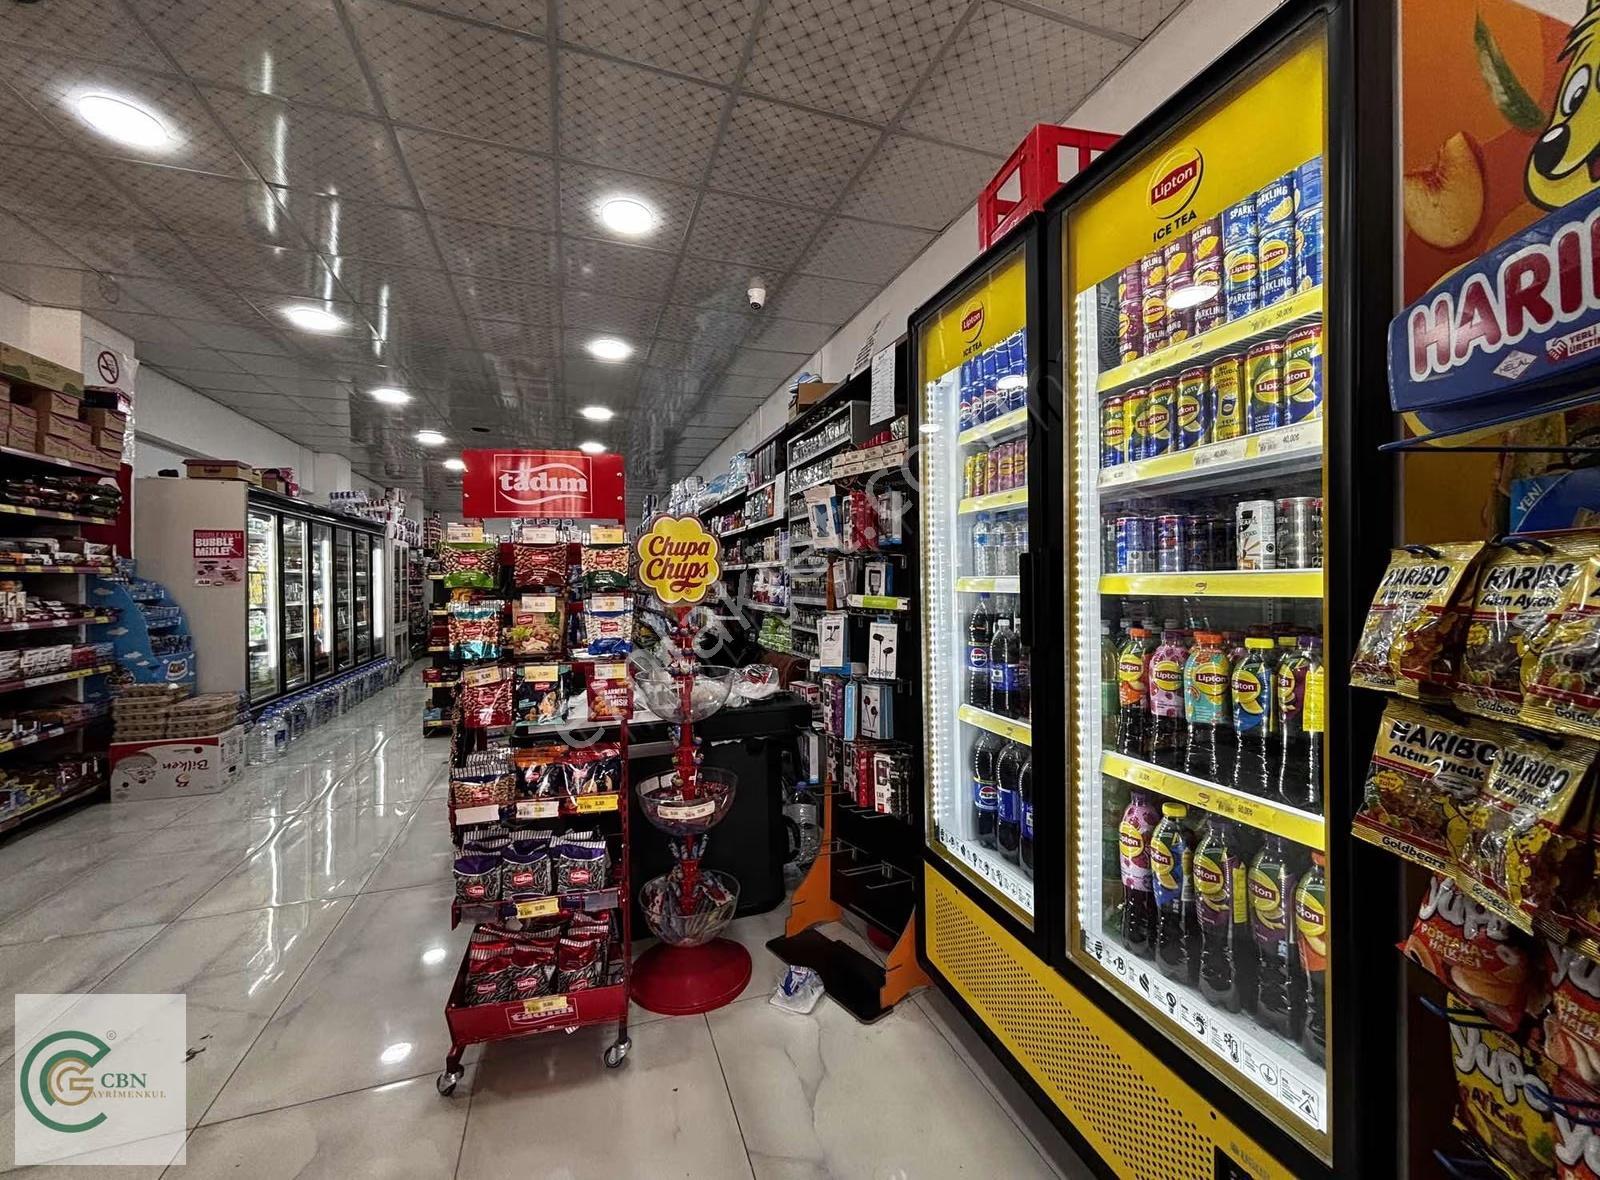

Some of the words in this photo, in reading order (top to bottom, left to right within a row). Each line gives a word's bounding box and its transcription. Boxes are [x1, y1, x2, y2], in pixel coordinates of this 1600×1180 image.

[1155, 166, 1194, 200] Lipton
[1152, 221, 1172, 243] ICE
[1174, 210, 1198, 231] TEA
[1409, 212, 1600, 382] HARI
[962, 311, 982, 330] Lipton
[195, 538, 234, 547] BUBBLE
[648, 535, 711, 562] Chupa
[646, 557, 709, 593] Chups
[1198, 674, 1227, 684] Lipton
[1390, 720, 1500, 767] HARIBO
[162, 759, 209, 772] Bilken
[1499, 750, 1571, 795] HARIBO
[1382, 835, 1447, 872] Goldbears
